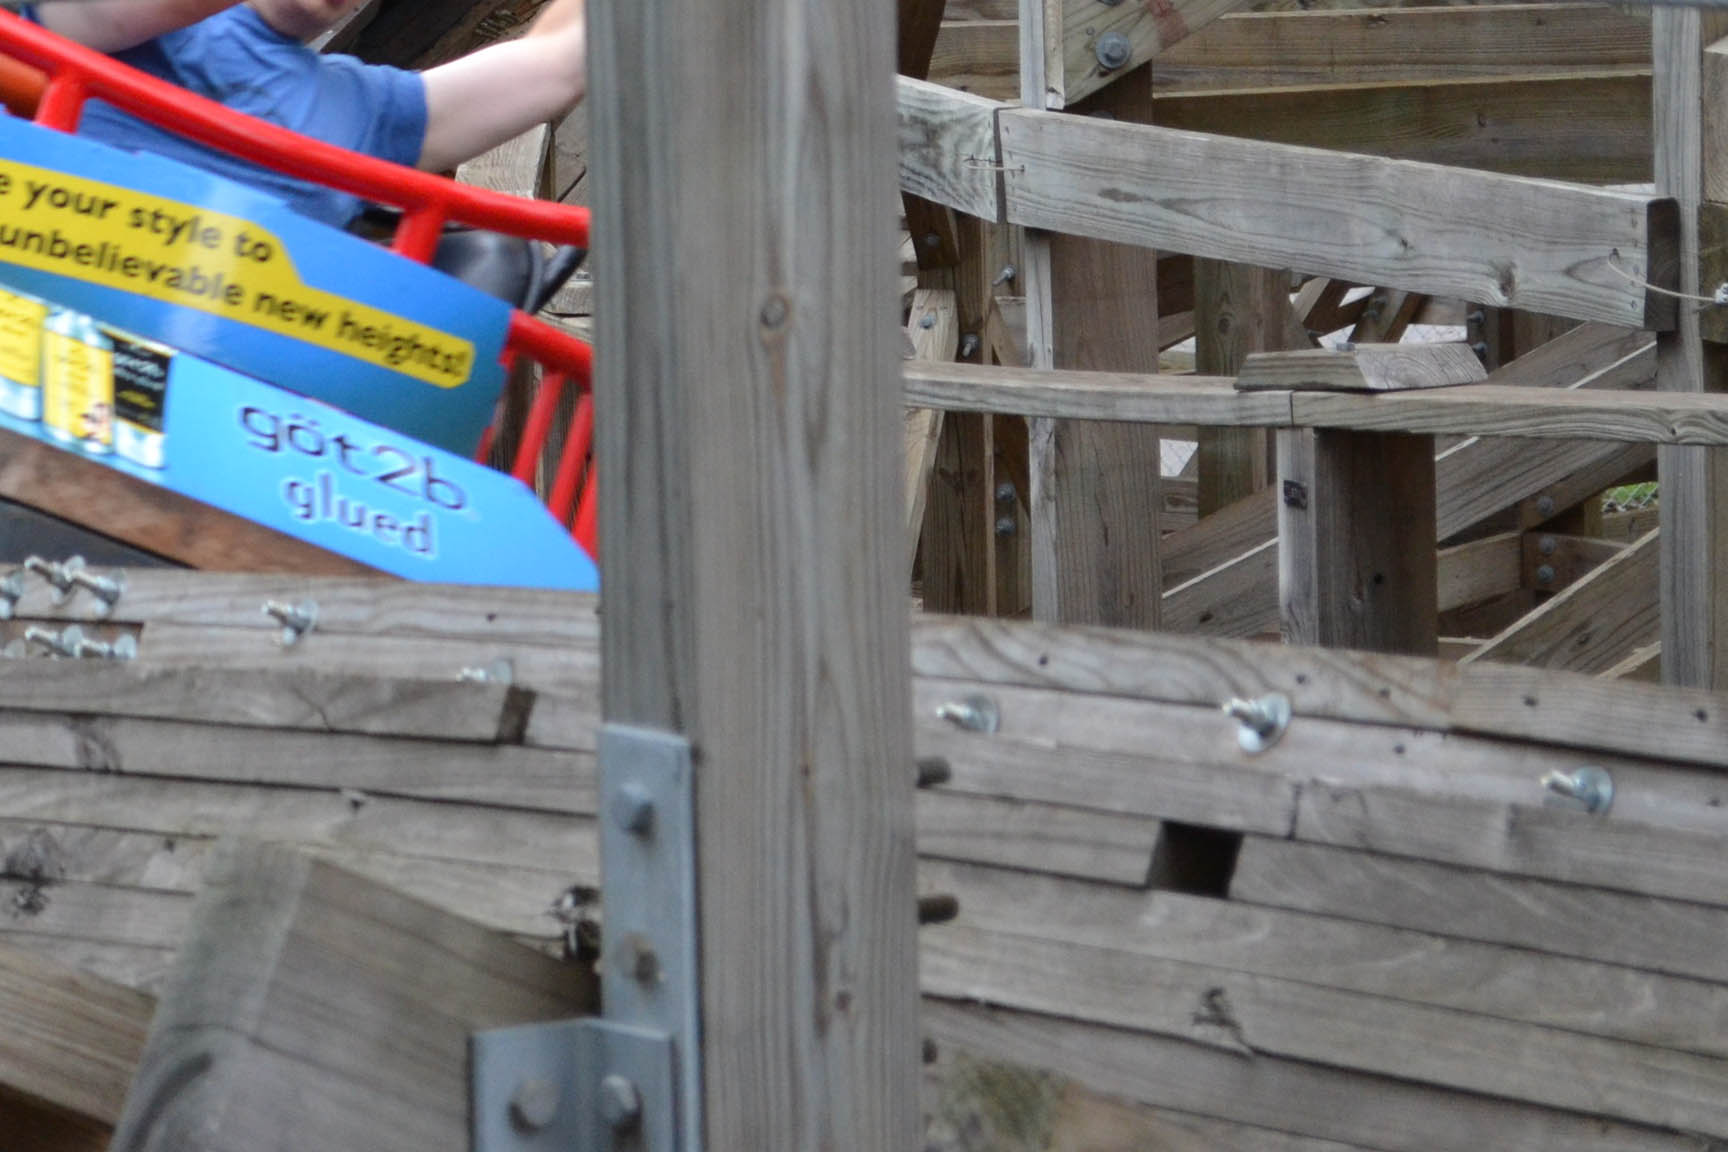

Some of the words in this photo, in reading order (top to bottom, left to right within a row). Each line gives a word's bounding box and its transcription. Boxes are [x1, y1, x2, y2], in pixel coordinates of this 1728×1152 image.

[23, 180, 119, 219] your
[129, 207, 222, 249] style
[233, 231, 274, 264] to
[254, 291, 330, 332] new
[336, 311, 469, 380] heights!
[239, 406, 469, 511] göt2b
[285, 474, 434, 554] glued
